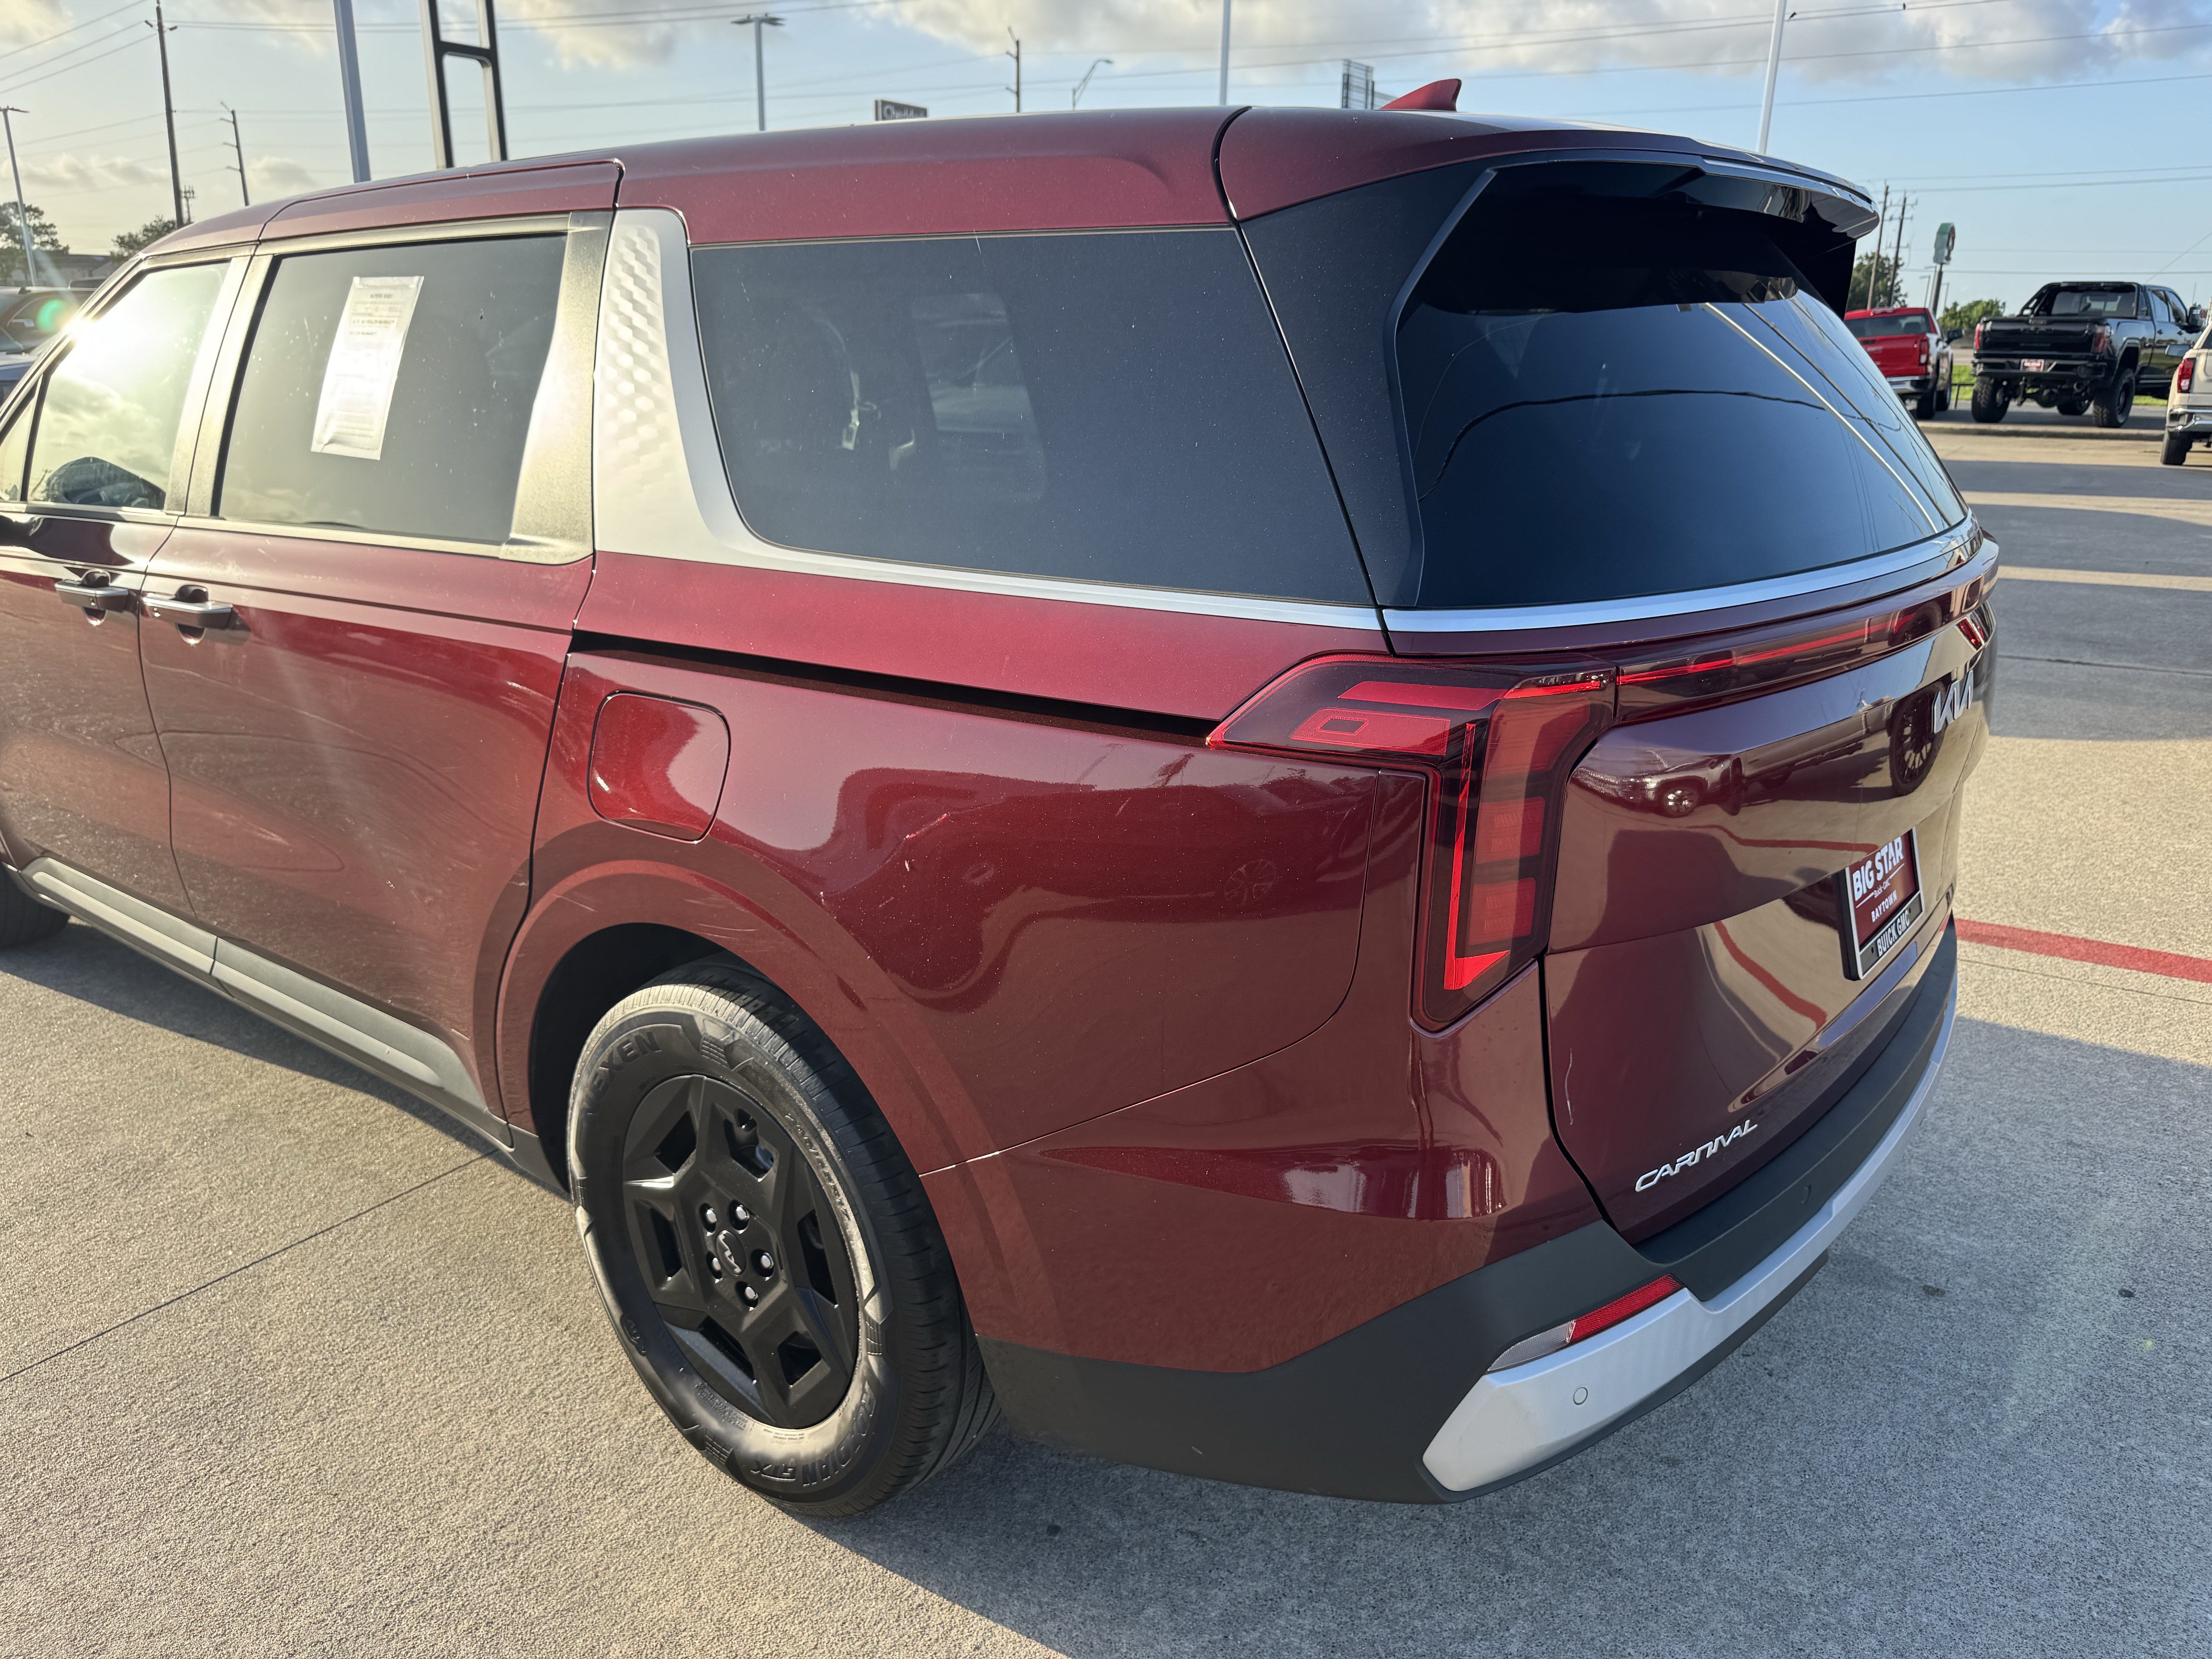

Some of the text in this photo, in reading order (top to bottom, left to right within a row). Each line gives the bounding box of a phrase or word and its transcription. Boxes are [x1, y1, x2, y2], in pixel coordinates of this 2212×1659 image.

[1853, 837, 1903, 901] BIG STAR
[1872, 890, 1897, 922] BAYTOWN
[1877, 910, 1910, 957] BUICK GMC
[583, 1031, 662, 1118] NEXEN
[1635, 1119, 1758, 1192] CARNIVAL
[802, 1380, 876, 1487] ROADIAN
